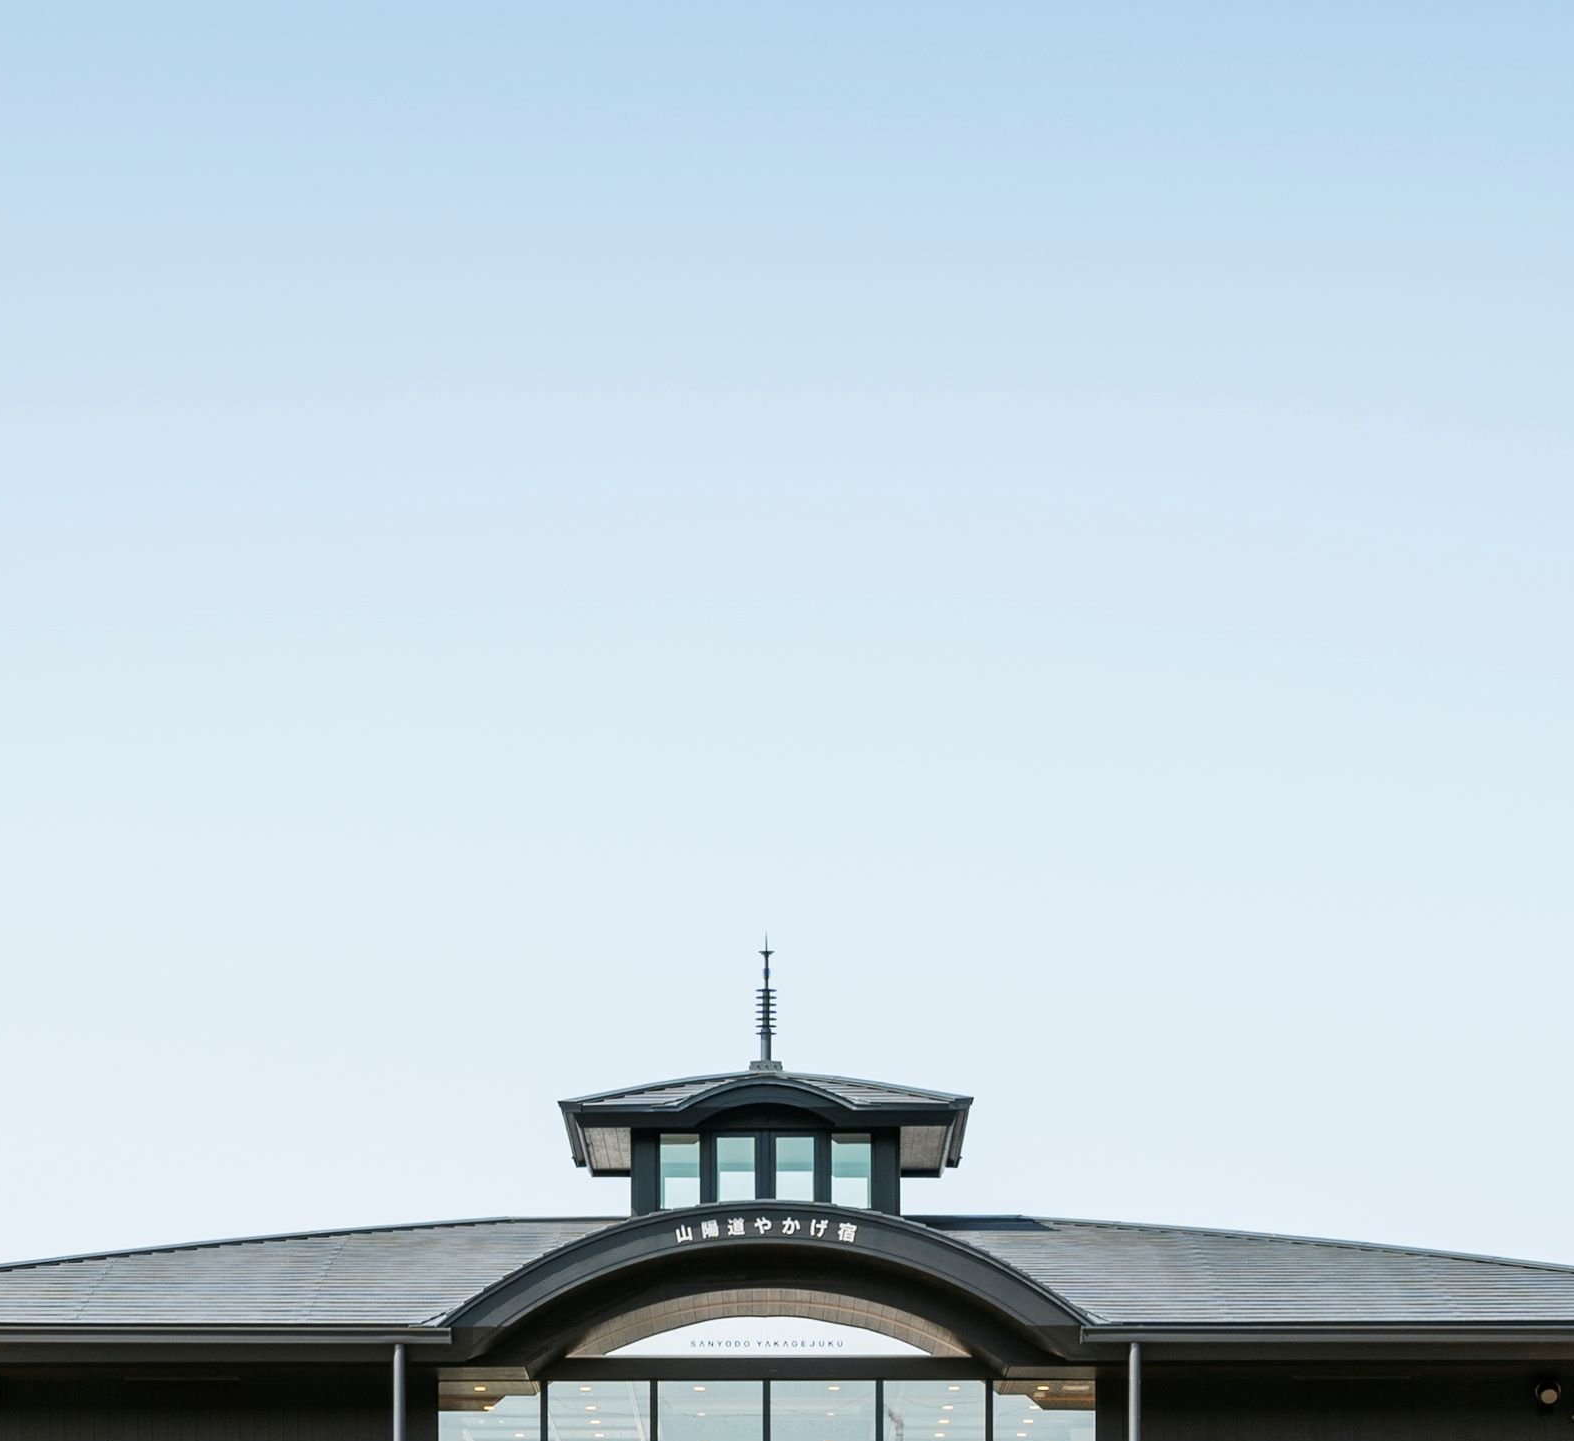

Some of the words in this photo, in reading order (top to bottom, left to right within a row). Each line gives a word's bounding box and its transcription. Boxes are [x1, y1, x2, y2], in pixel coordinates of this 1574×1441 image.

[675, 1217, 857, 1243] 山陽道やかげ宿
